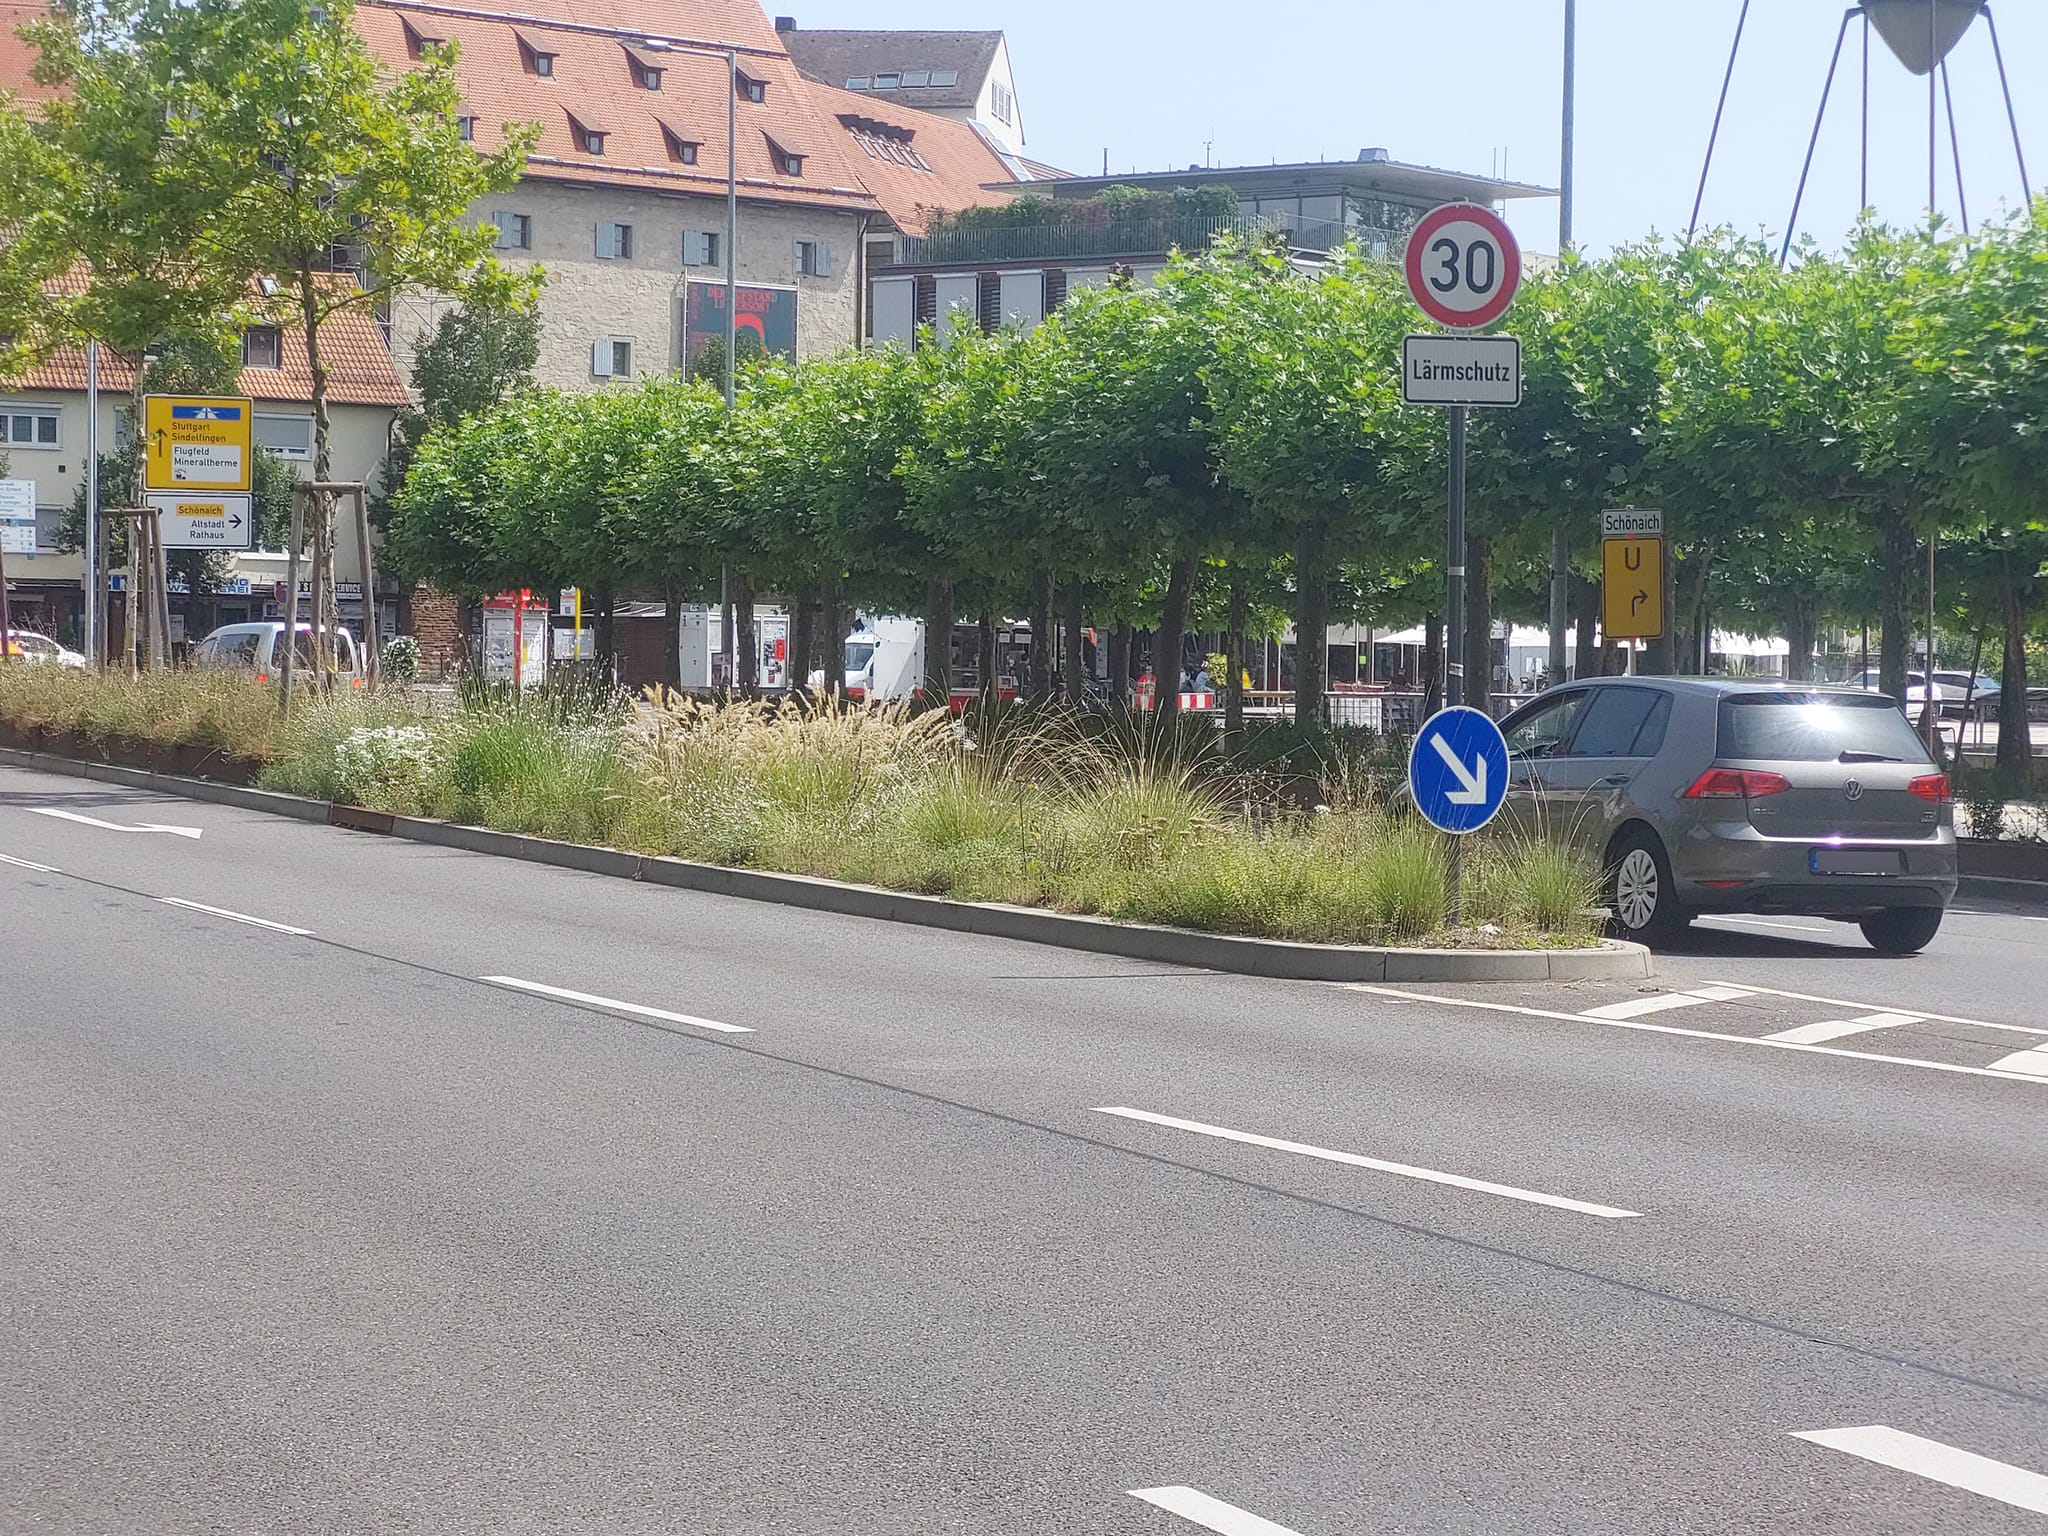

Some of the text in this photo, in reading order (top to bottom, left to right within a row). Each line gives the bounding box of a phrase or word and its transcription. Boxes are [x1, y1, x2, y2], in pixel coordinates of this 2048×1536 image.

[1430, 238, 1495, 295] 30
[1413, 359, 1510, 382] Lärmschutz
[172, 421, 211, 432] Stuttgart
[172, 432, 226, 443] Sindelfingen
[174, 446, 210, 457] Flugfeld
[174, 457, 238, 468] Mineraltherme
[178, 505, 223, 515] Schönaich
[191, 519, 225, 529] Altstadt
[1605, 514, 1660, 531] Schönaich
[189, 530, 225, 539] Rathaus
[1624, 546, 1641, 571] U
[336, 583, 361, 593] ERVICE
